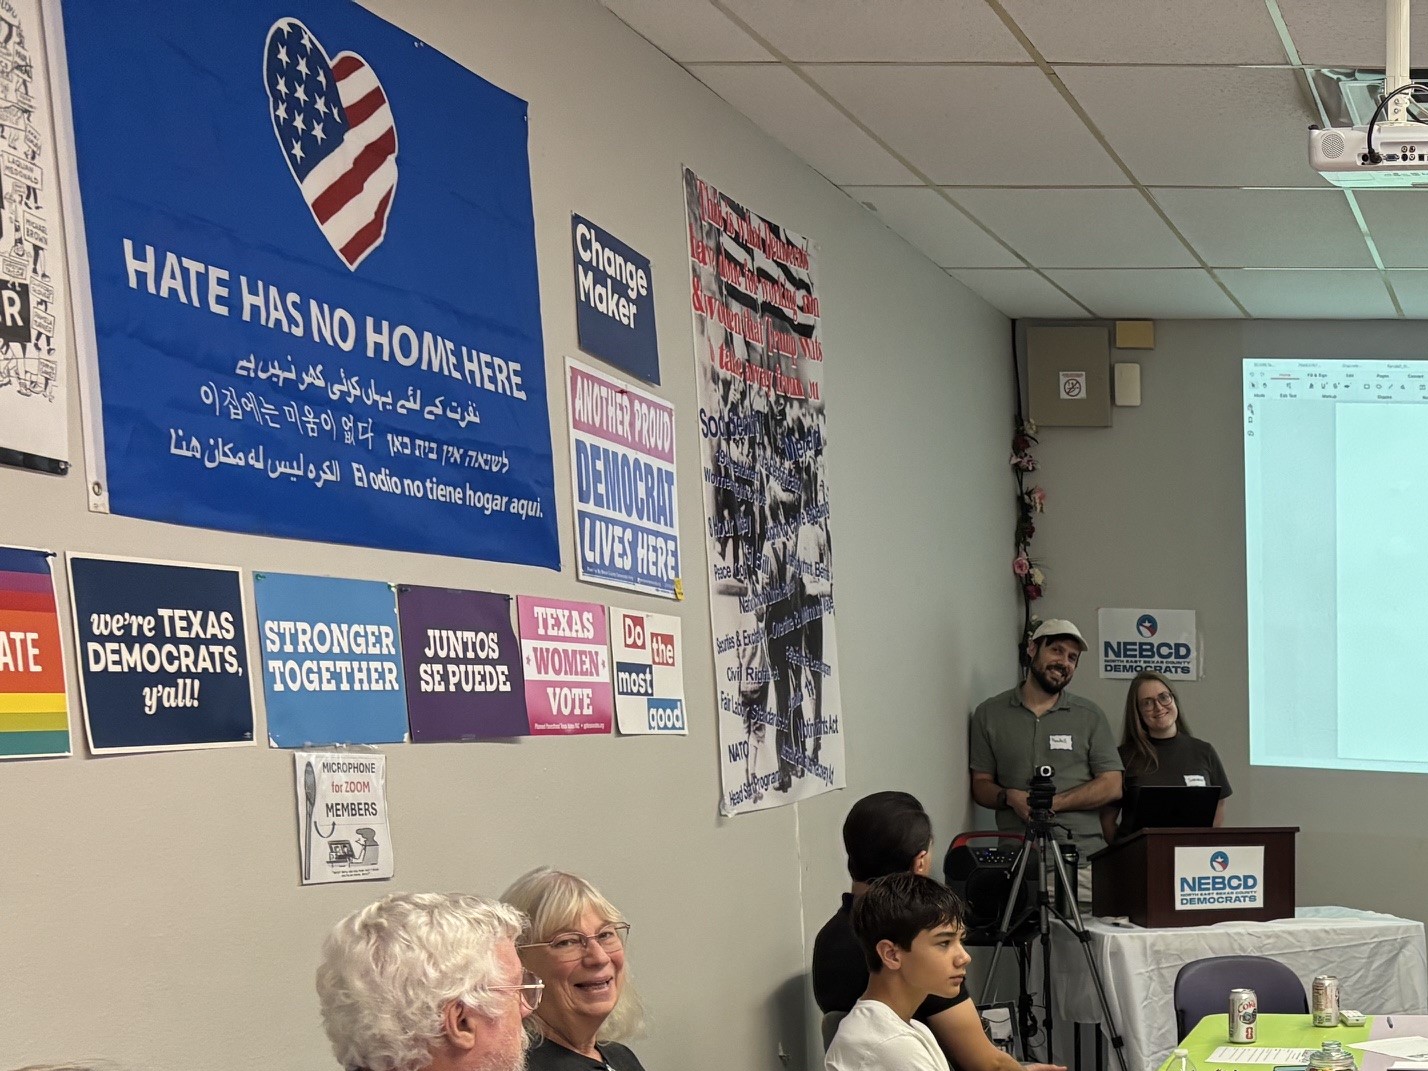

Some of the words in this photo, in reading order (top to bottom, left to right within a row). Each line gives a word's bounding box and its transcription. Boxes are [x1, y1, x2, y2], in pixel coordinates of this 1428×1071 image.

[576, 223, 648, 300] Change
[577, 264, 638, 329] Maker
[123, 238, 229, 316] HATE
[240, 275, 304, 337] HAS
[309, 299, 356, 351] NO
[365, 316, 463, 380] HOME
[462, 346, 527, 401] HERE
[575, 375, 632, 444] ANOTHER
[634, 402, 671, 454] PROUD
[170, 428, 201, 459] هنا
[204, 438, 245, 469] مكان
[387, 433, 411, 457] כאן
[415, 438, 438, 460] בית
[442, 444, 463, 466] אין
[267, 453, 304, 482] ليس
[465, 450, 510, 474] לשנאה
[351, 462, 368, 488] El
[369, 467, 401, 494] odio
[403, 479, 424, 498] no
[425, 477, 463, 505] tiene
[465, 483, 509, 515] hogar
[575, 438, 674, 528] DEMOCRAT
[584, 517, 633, 573] LIVES
[637, 530, 676, 582] HERE
[90, 612, 156, 638] we're
[157, 608, 235, 640] TEXAS
[534, 606, 594, 640] TEXAS
[625, 618, 643, 646] Do
[265, 621, 396, 655] STRONGER
[424, 629, 499, 659] JUNTOS
[652, 637, 674, 664] the
[1104, 641, 1191, 659] NEBCD
[87, 642, 243, 676] DEMOCRATS,
[533, 647, 600, 677] WOMEN
[1104, 664, 1190, 674] DEMOCRATS
[269, 660, 399, 692] TOGETHER
[419, 664, 445, 692] SE
[447, 664, 511, 692] PUEDE
[618, 668, 653, 694] most
[142, 679, 200, 715] y'all!
[547, 687, 593, 716] VOTE
[649, 702, 683, 731] good
[728, 741, 749, 763] NATO
[322, 762, 376, 774] MICROPHONE
[331, 781, 343, 793] for
[344, 781, 371, 793] ZOOM
[326, 802, 378, 818] MEMBERS
[1180, 875, 1257, 892] NEBCD
[1181, 895, 1257, 905] DEMOCRATS
